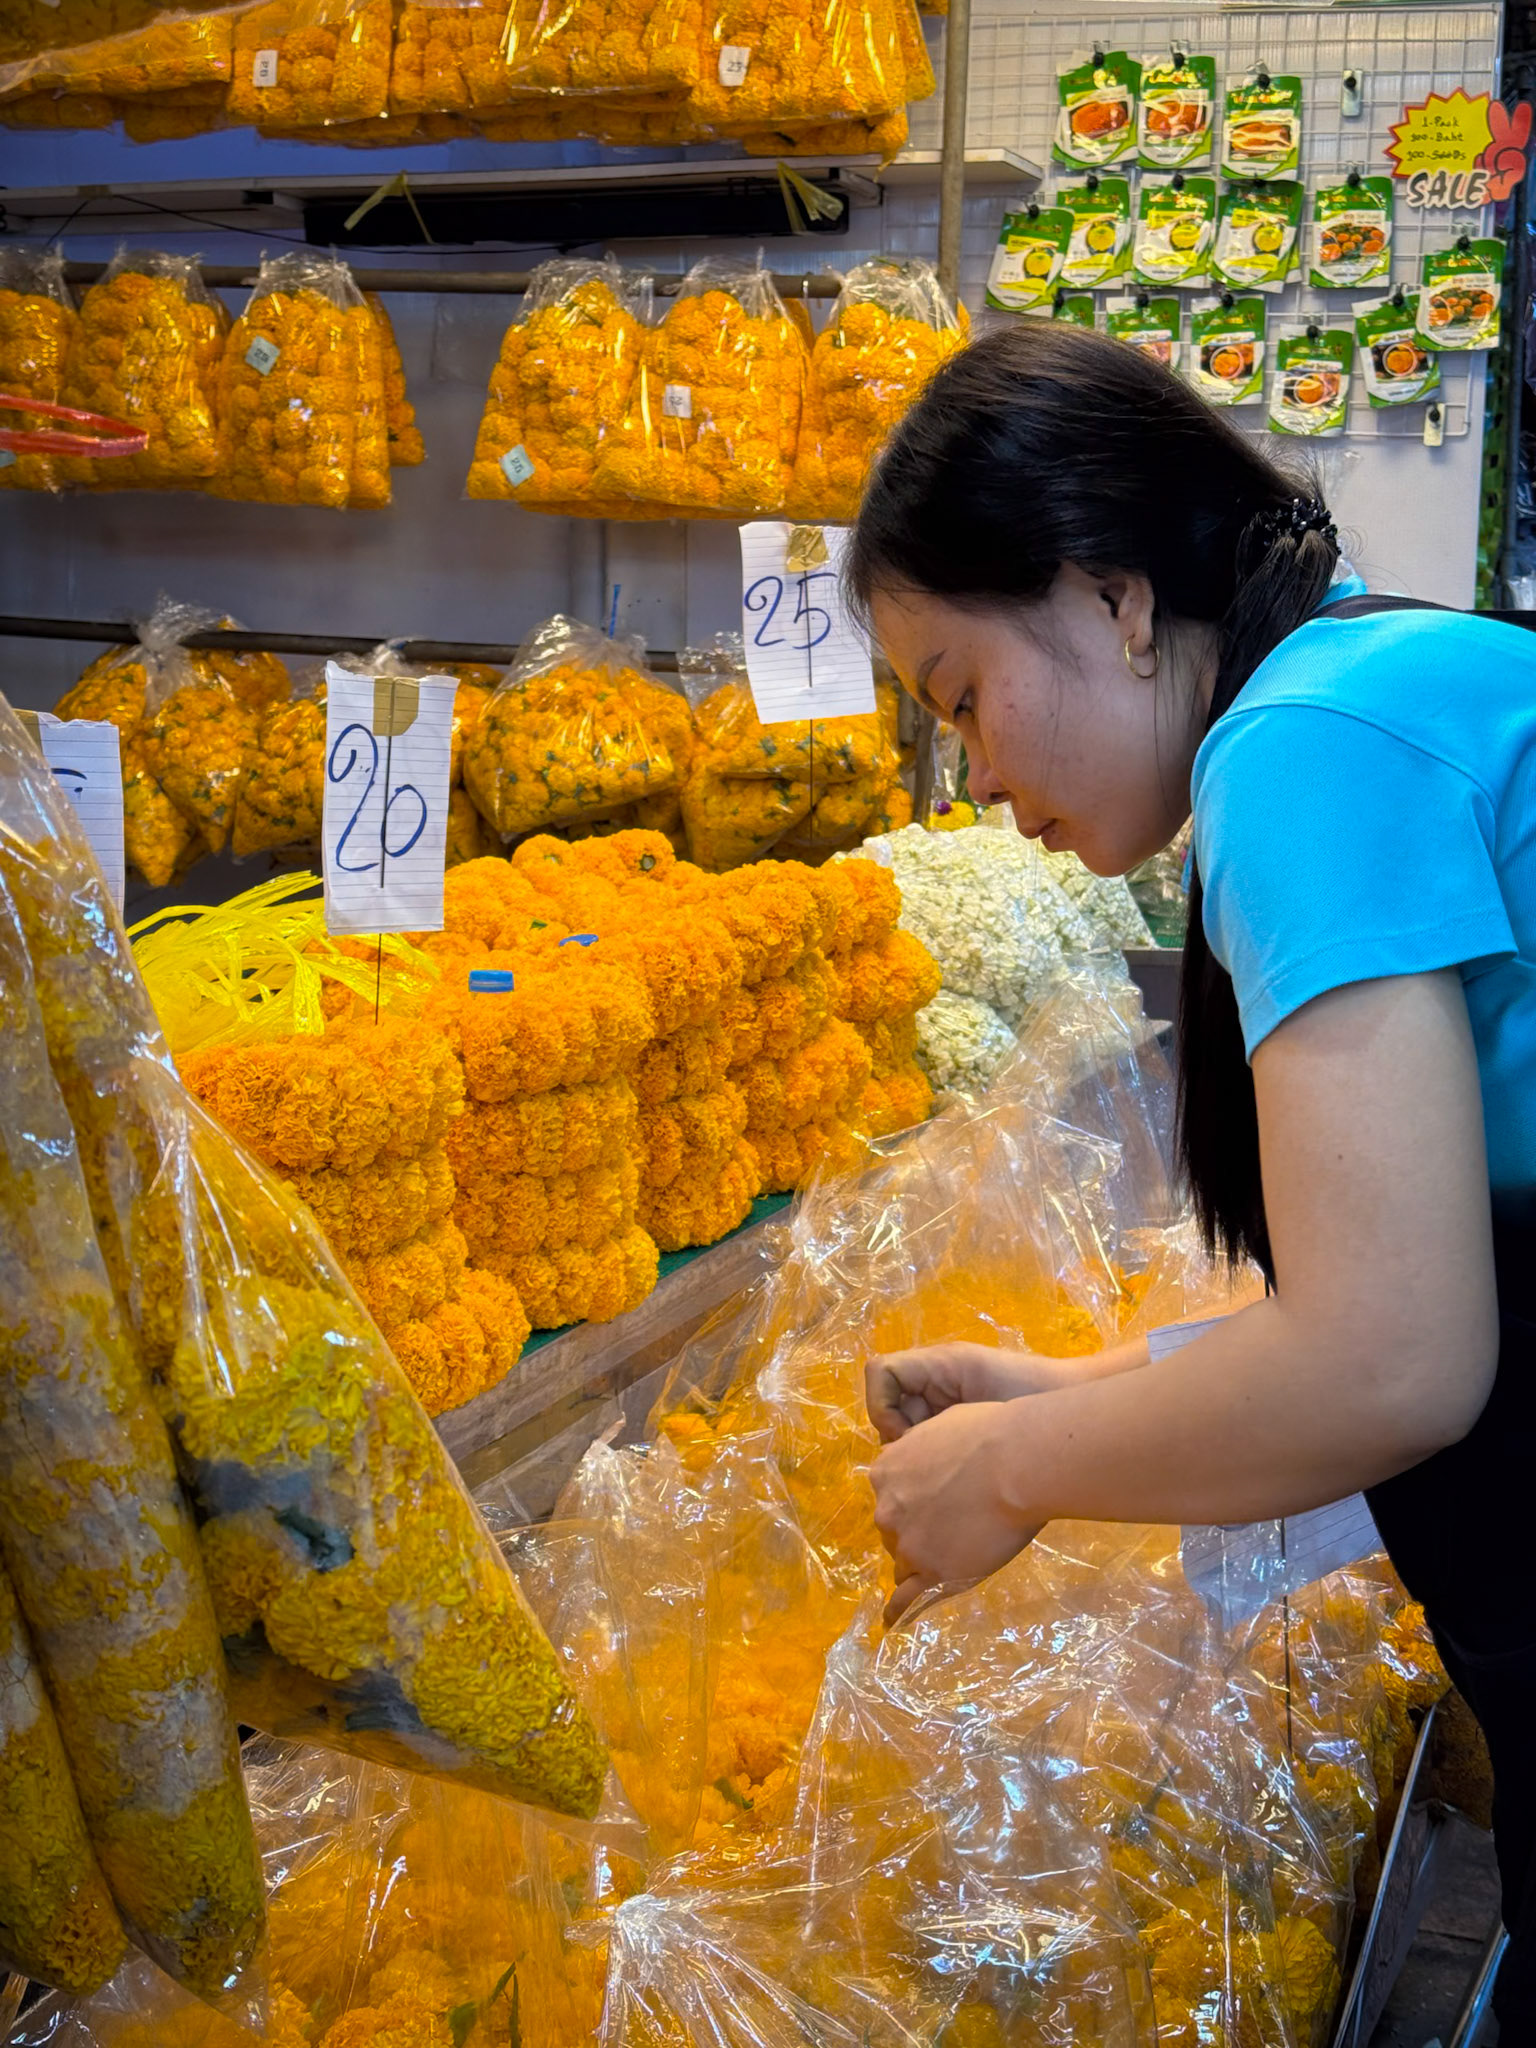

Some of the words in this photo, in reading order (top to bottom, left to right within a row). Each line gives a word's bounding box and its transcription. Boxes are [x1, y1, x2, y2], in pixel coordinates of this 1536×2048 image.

[1407, 169, 1489, 206] SALE
[743, 571, 839, 650] 25
[327, 722, 428, 872] 20
